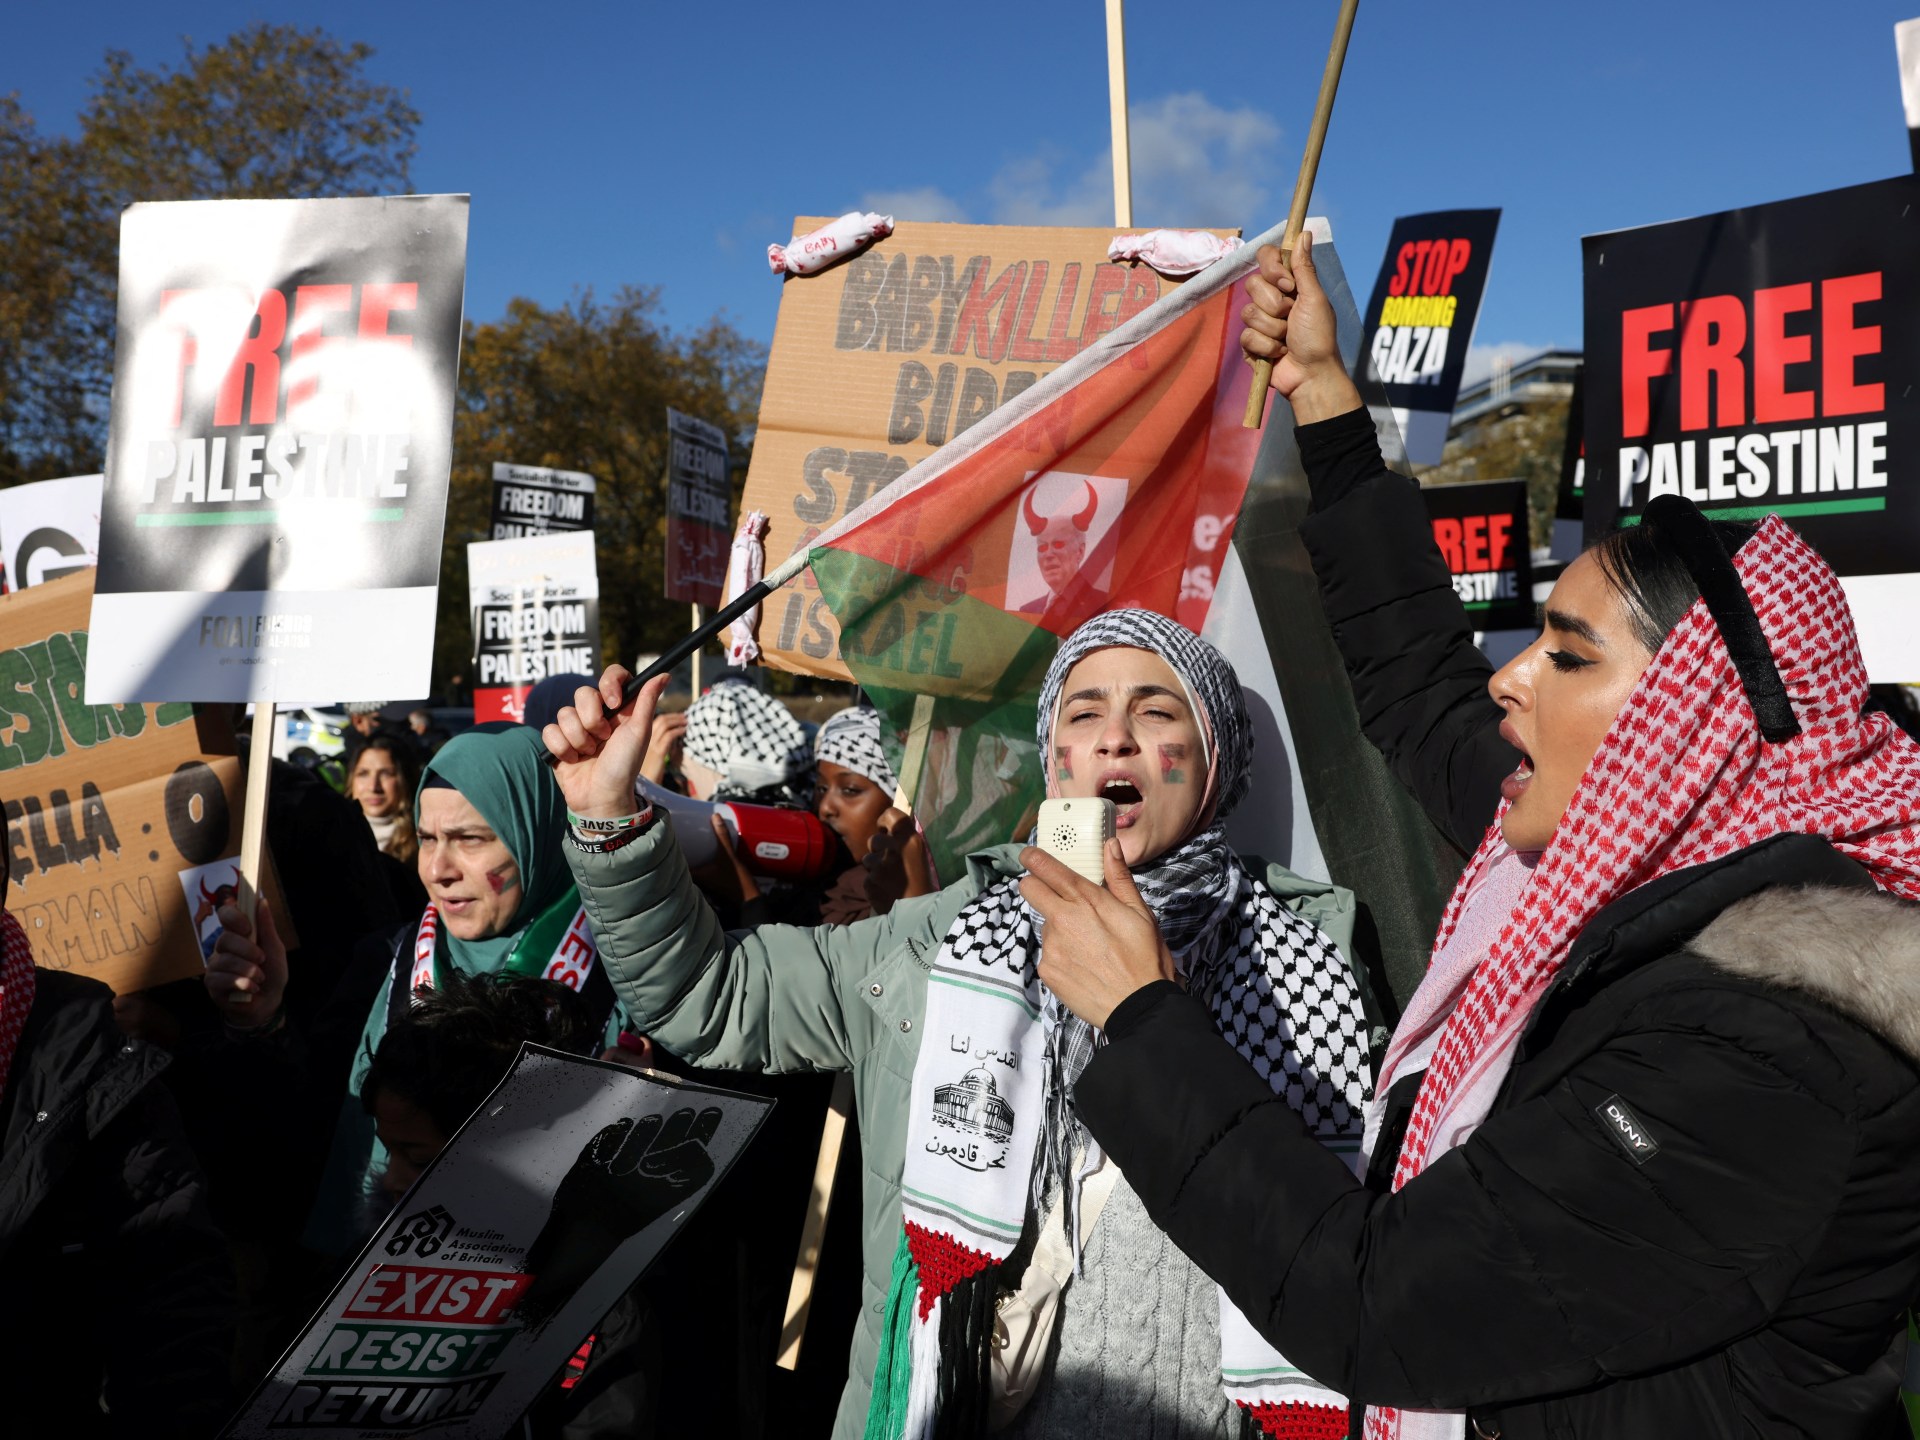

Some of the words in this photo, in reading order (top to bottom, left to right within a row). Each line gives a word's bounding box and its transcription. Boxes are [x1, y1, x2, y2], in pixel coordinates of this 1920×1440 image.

[1389, 238, 1472, 297] STOP
[1378, 295, 1458, 328] BOMBING
[156, 282, 419, 427] REE
[1367, 327, 1450, 386] GAZA
[1621, 270, 1886, 438] FREE
[141, 433, 410, 504] PALESTINE
[1618, 421, 1888, 507] PALESTINE
[500, 486, 585, 520] FREEDOM
[1431, 512, 1516, 574] REE
[1451, 571, 1519, 602] ESTINE
[484, 604, 586, 639] FREEDOM
[480, 647, 594, 684] PALESTINE
[579, 818, 615, 831] SAVE
[1606, 1104, 1648, 1149] DKNY
[448, 1239, 526, 1255] Association
[456, 1227, 505, 1242] Muslim
[441, 1252, 457, 1262] of
[459, 1253, 504, 1265] Britain
[347, 1272, 518, 1319] EXIST.
[311, 1328, 501, 1376] RESIST.
